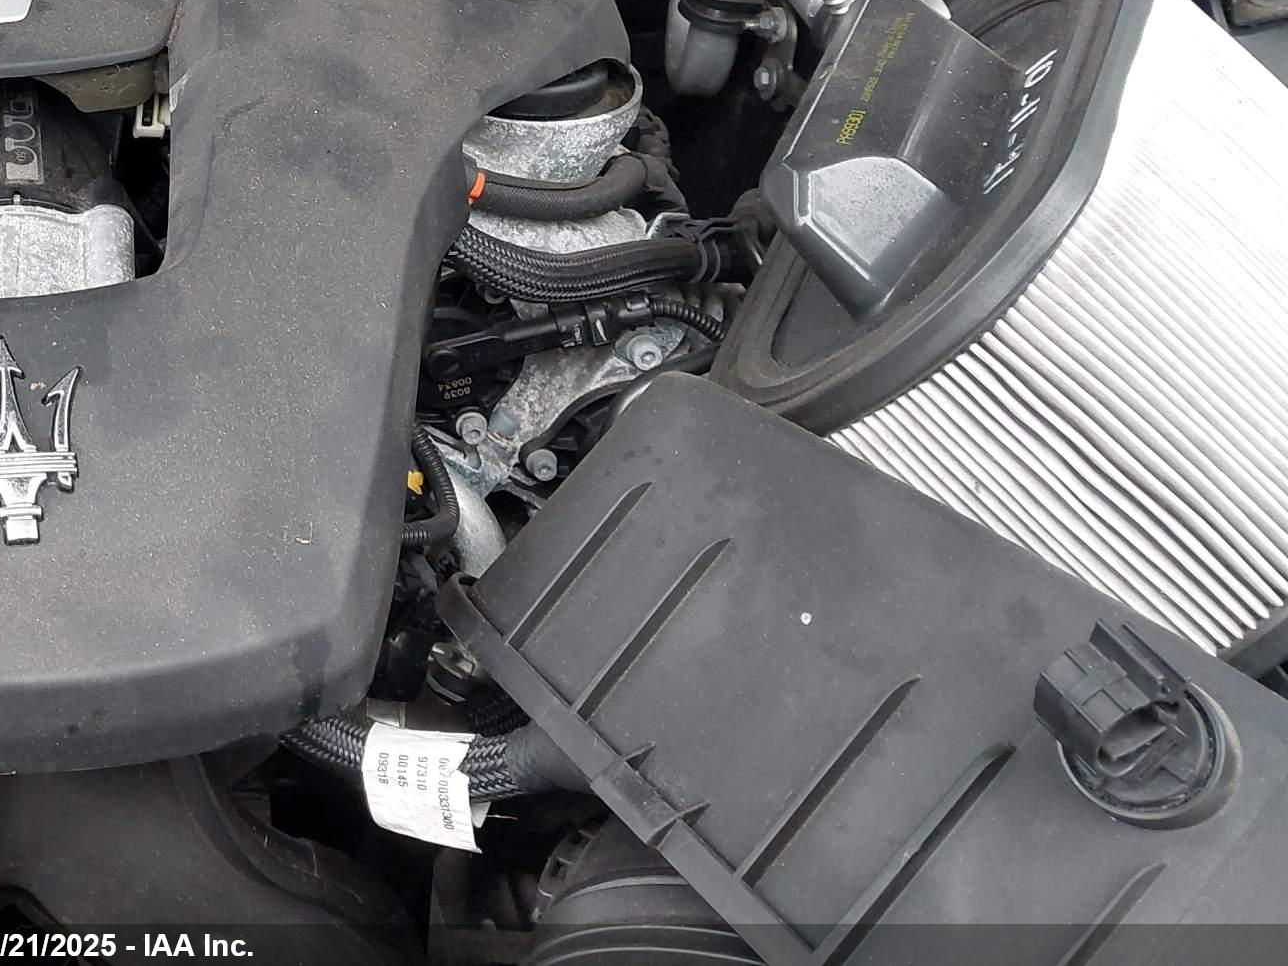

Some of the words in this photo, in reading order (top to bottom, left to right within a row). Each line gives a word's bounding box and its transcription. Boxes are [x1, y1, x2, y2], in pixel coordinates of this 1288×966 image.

[376, 752, 390, 785] 09318
[396, 754, 409, 788] 00145
[416, 756, 429, 791] 97310
